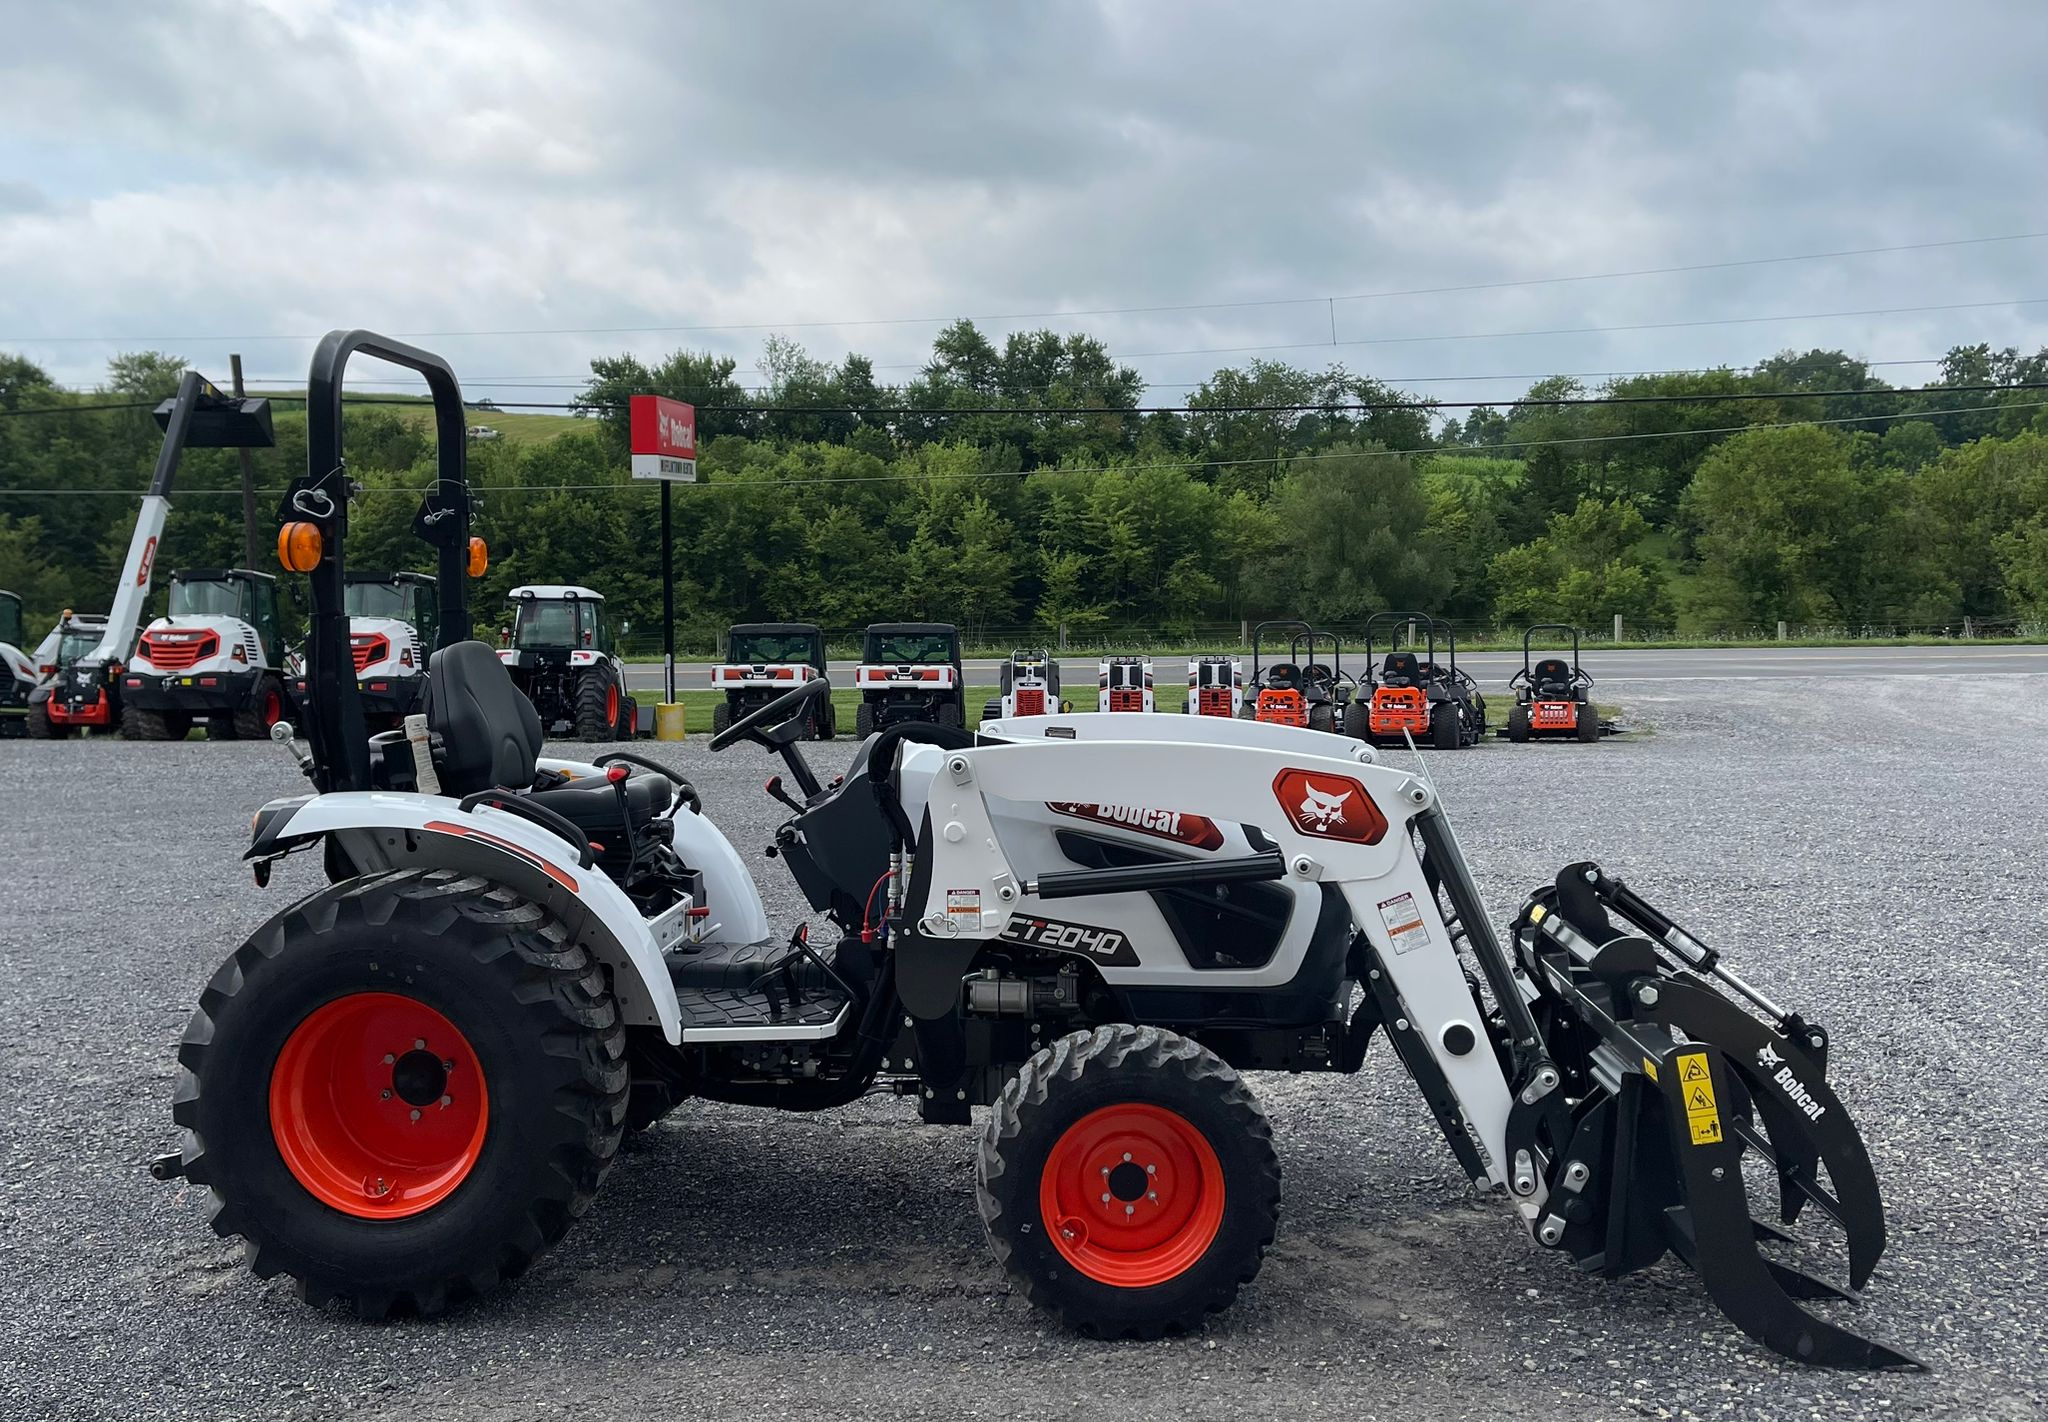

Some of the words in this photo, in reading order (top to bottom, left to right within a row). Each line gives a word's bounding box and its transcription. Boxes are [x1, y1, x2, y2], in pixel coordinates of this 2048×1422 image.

[671, 418, 693, 449] Bobcat
[1001, 916, 1123, 955] CT2040
[1773, 1065, 1826, 1121] Bobcat
